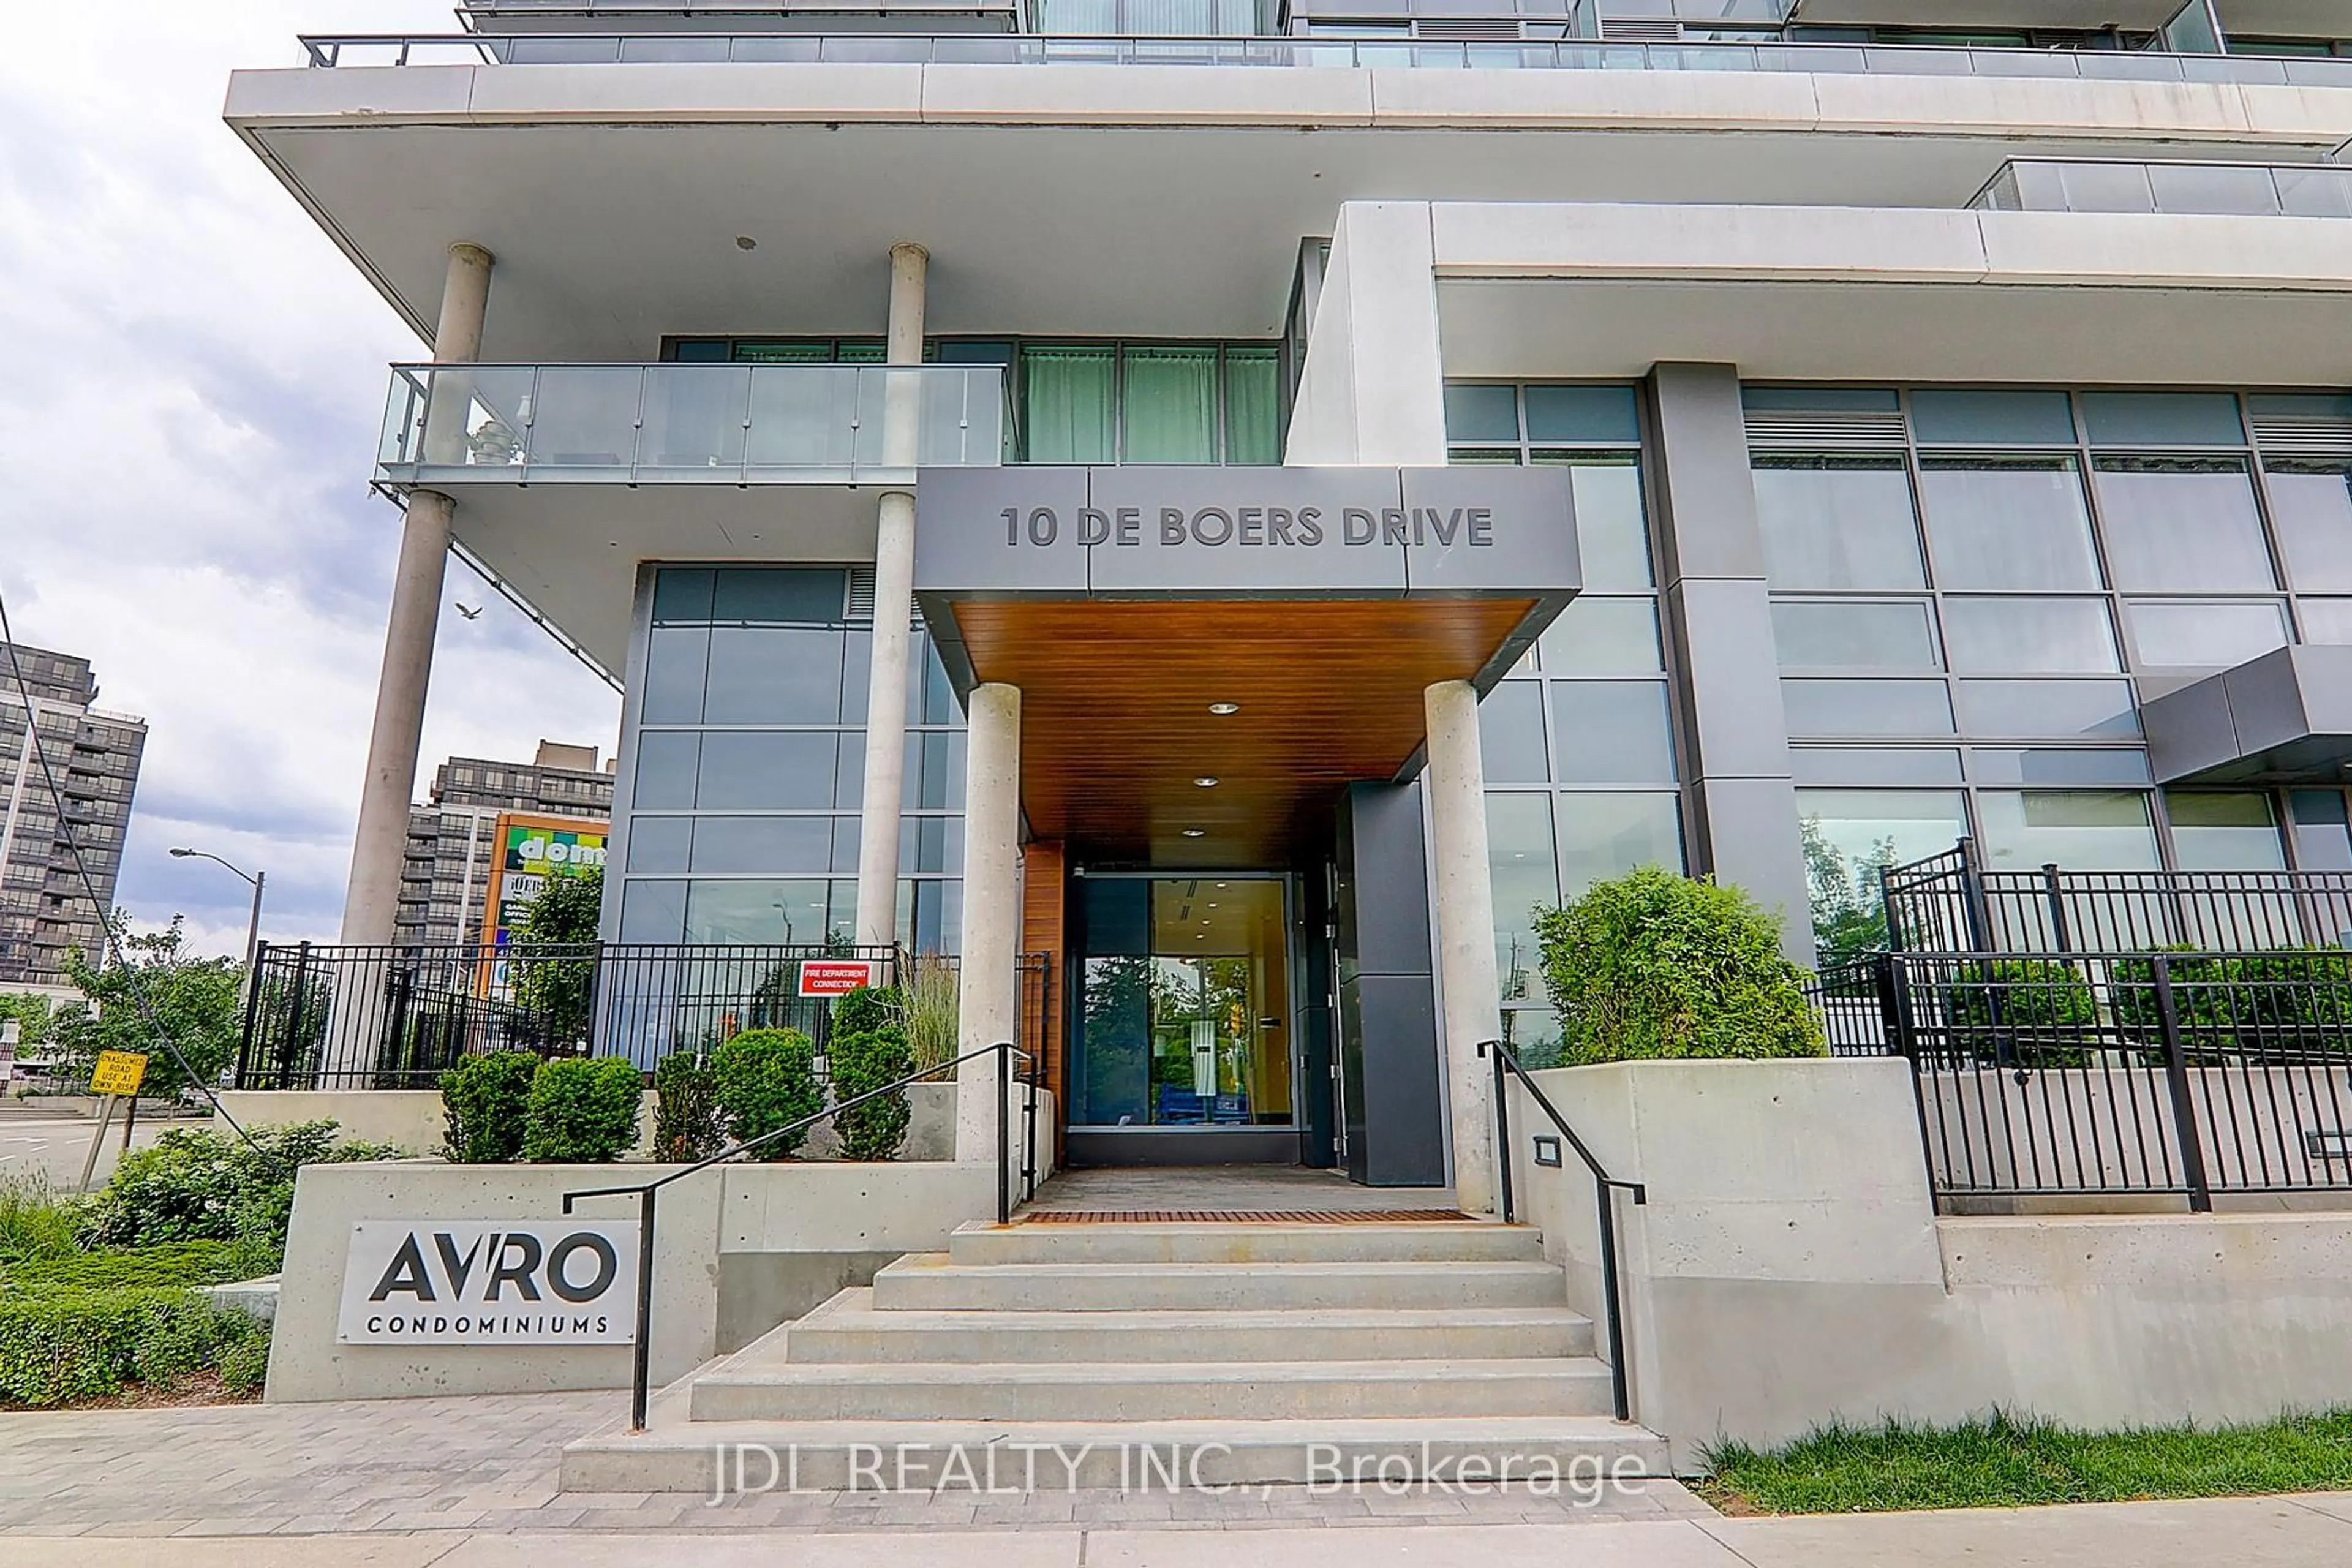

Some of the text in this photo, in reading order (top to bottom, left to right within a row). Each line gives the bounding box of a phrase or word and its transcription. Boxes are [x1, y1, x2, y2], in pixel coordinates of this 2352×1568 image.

[1000, 506, 1493, 547] 10 DE BOERS DRIVE
[108, 1063, 131, 1074] ROAD
[102, 1072, 118, 1081] USE
[116, 1082, 135, 1091] RISK
[368, 1230, 618, 1303] AVRO
[368, 1316, 609, 1334] CONDOMINIUMS
